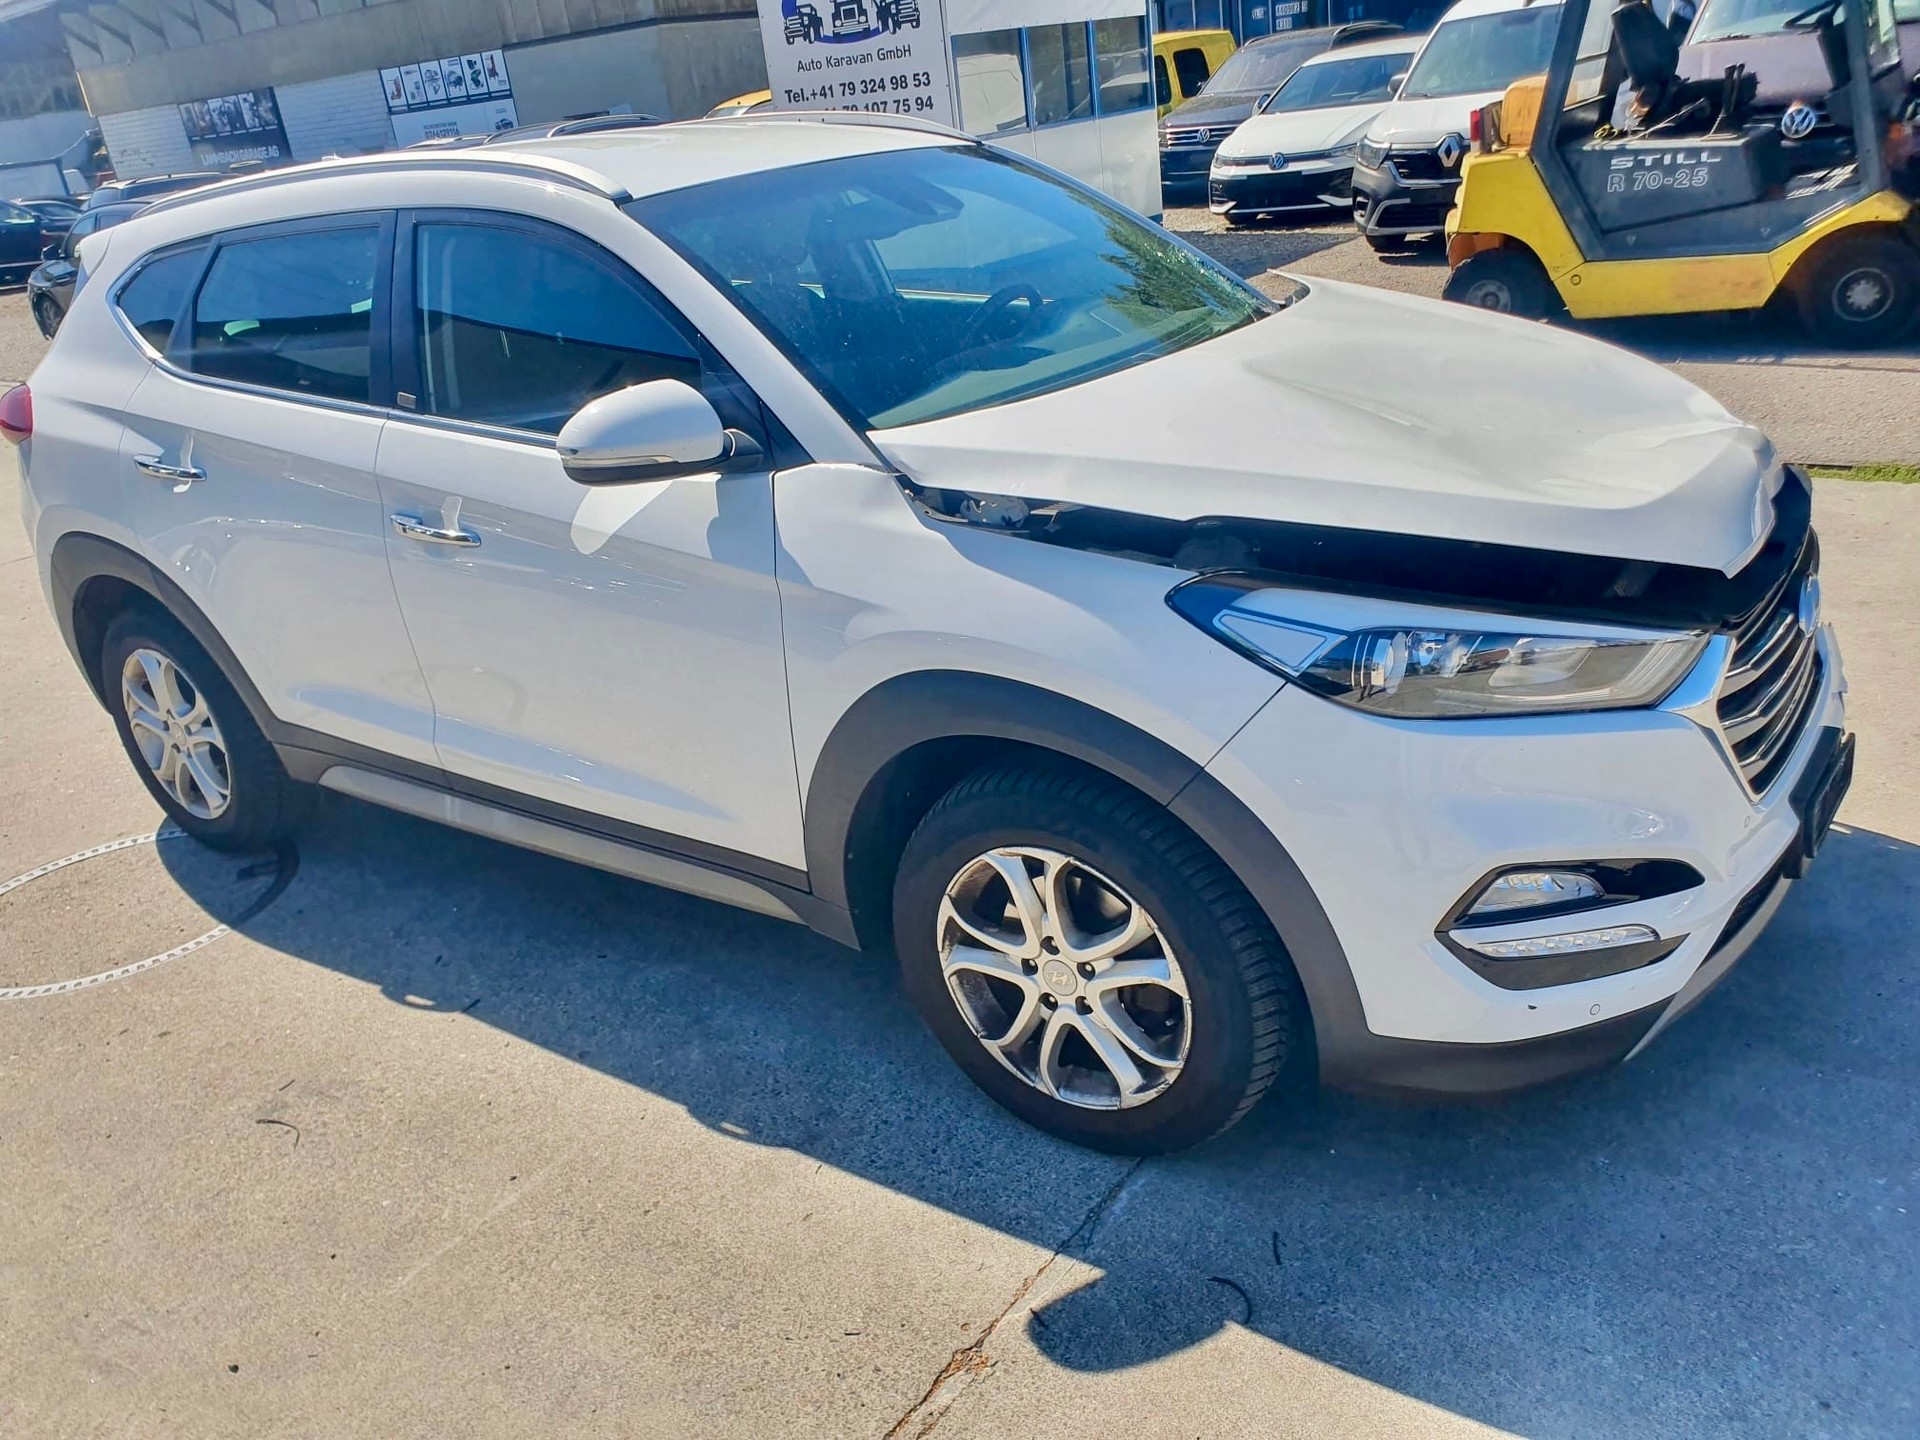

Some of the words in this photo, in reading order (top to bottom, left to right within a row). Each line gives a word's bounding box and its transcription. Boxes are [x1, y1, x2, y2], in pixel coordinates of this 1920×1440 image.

[797, 58, 822, 73] Auto
[825, 52, 873, 69] Karavan
[877, 44, 912, 61] GmbH
[785, 83, 835, 104] Tel.+41
[839, 81, 856, 97] 79
[860, 77, 887, 94] 324
[890, 74, 908, 91] 98
[912, 71, 931, 87] 53
[893, 98, 911, 114] 75
[915, 95, 934, 111] 94
[1610, 151, 1722, 170] STILL
[1607, 173, 1625, 193] R
[1633, 167, 1709, 191] 70-25
